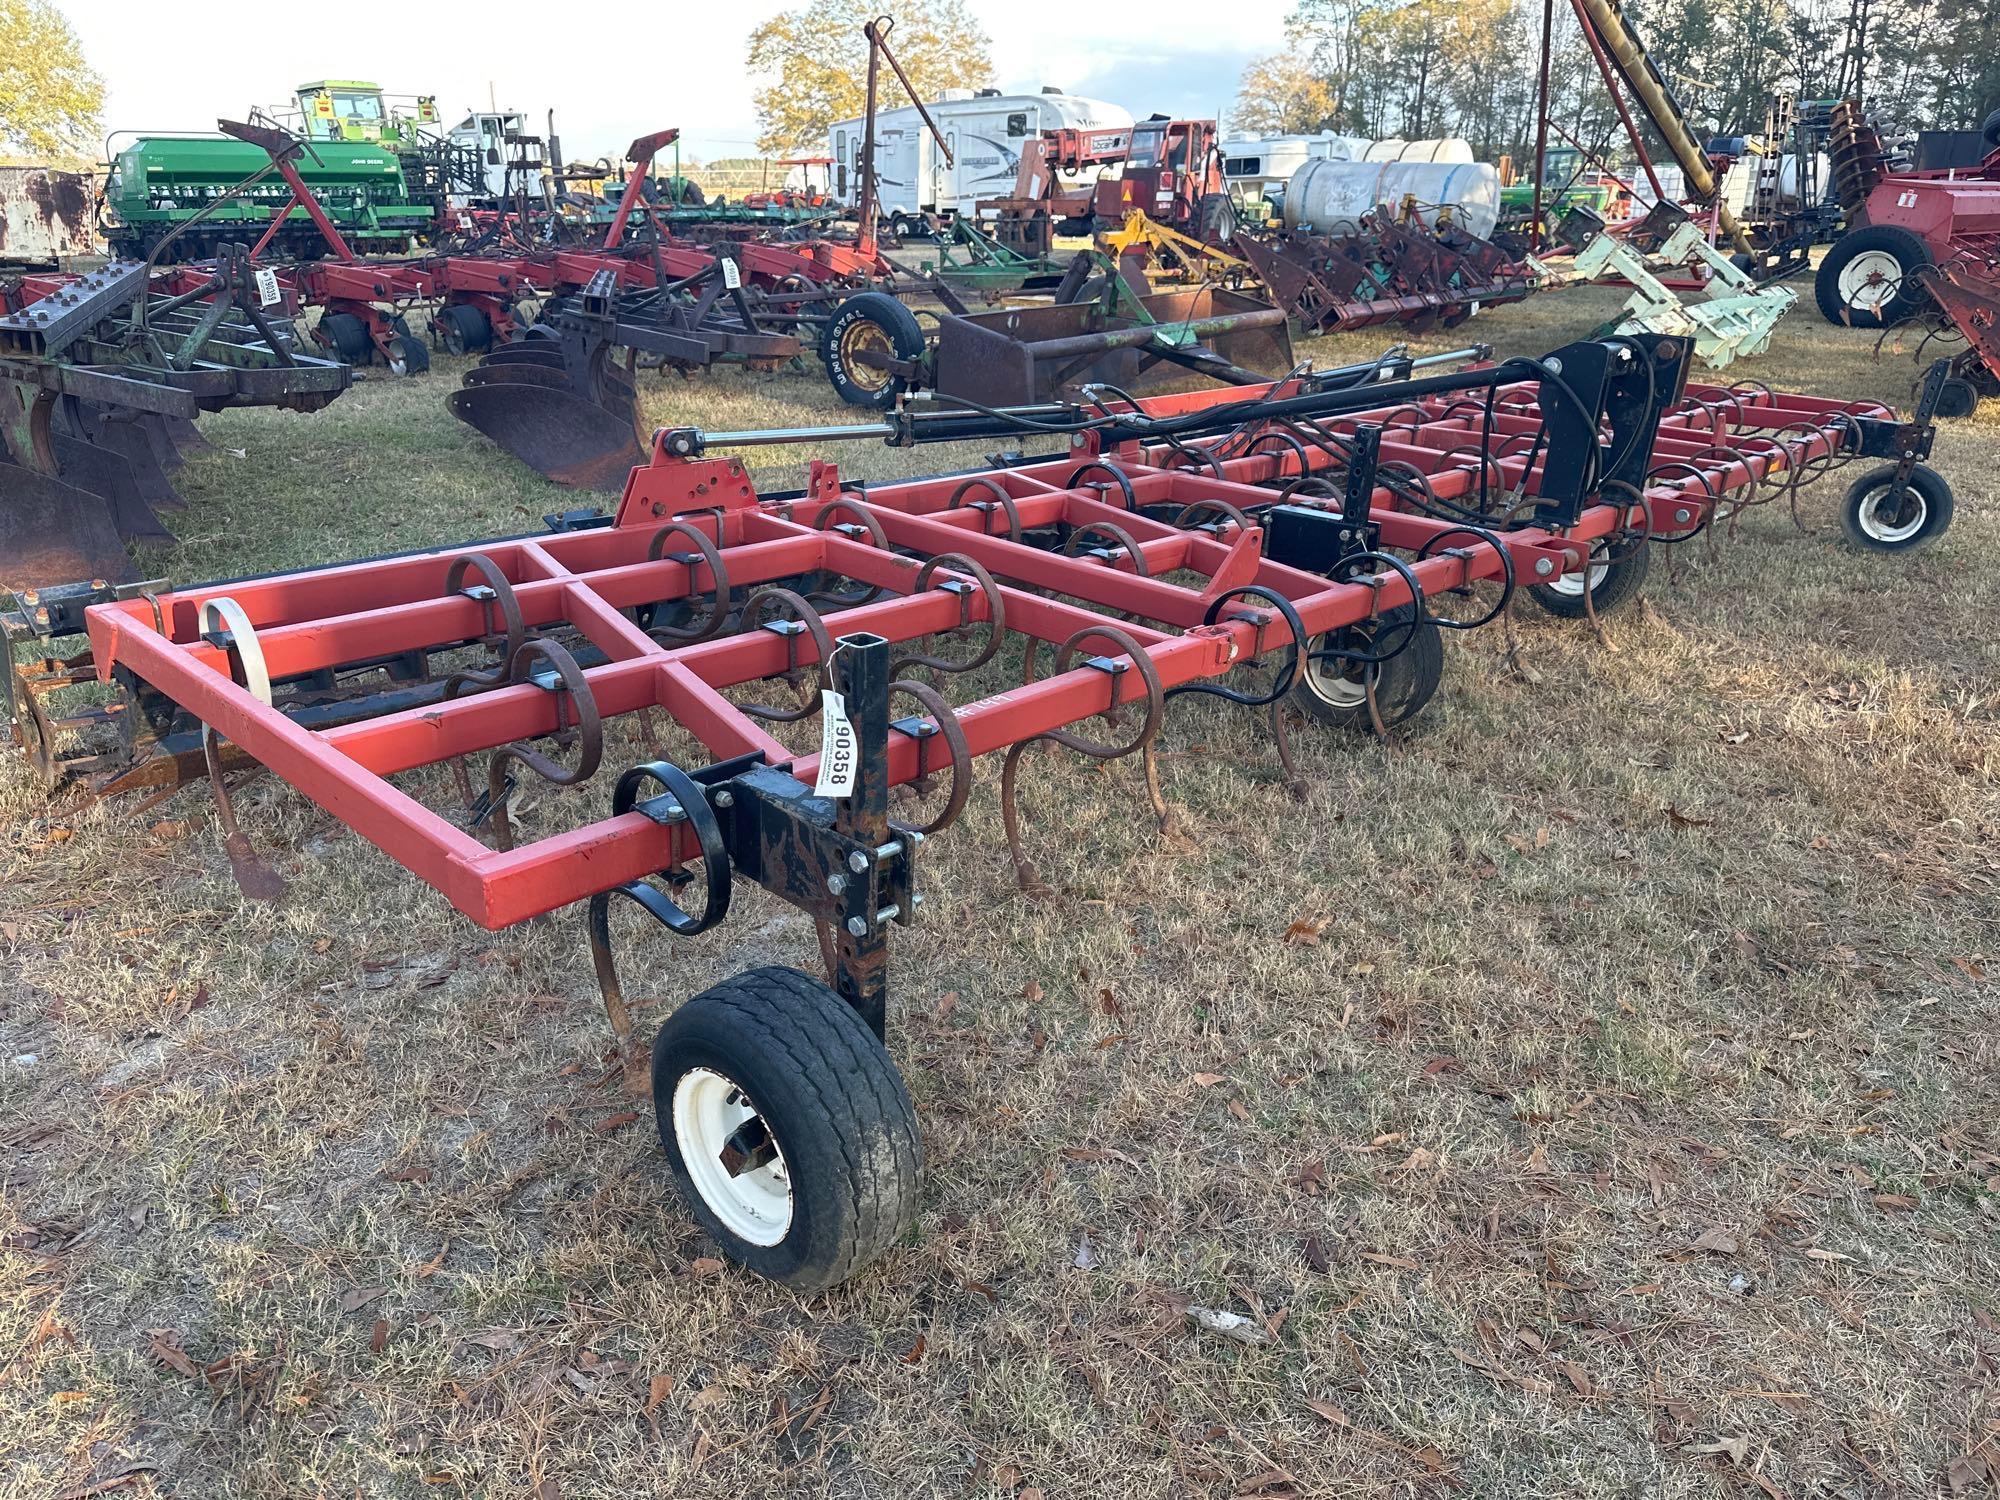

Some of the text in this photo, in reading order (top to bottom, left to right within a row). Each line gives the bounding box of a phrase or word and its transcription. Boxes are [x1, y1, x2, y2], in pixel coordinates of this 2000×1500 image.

[264, 277, 277, 301] 190359
[830, 310, 865, 385] UNIROYAL
[825, 756, 833, 781] COMPANY
[831, 716, 851, 785] 190358
